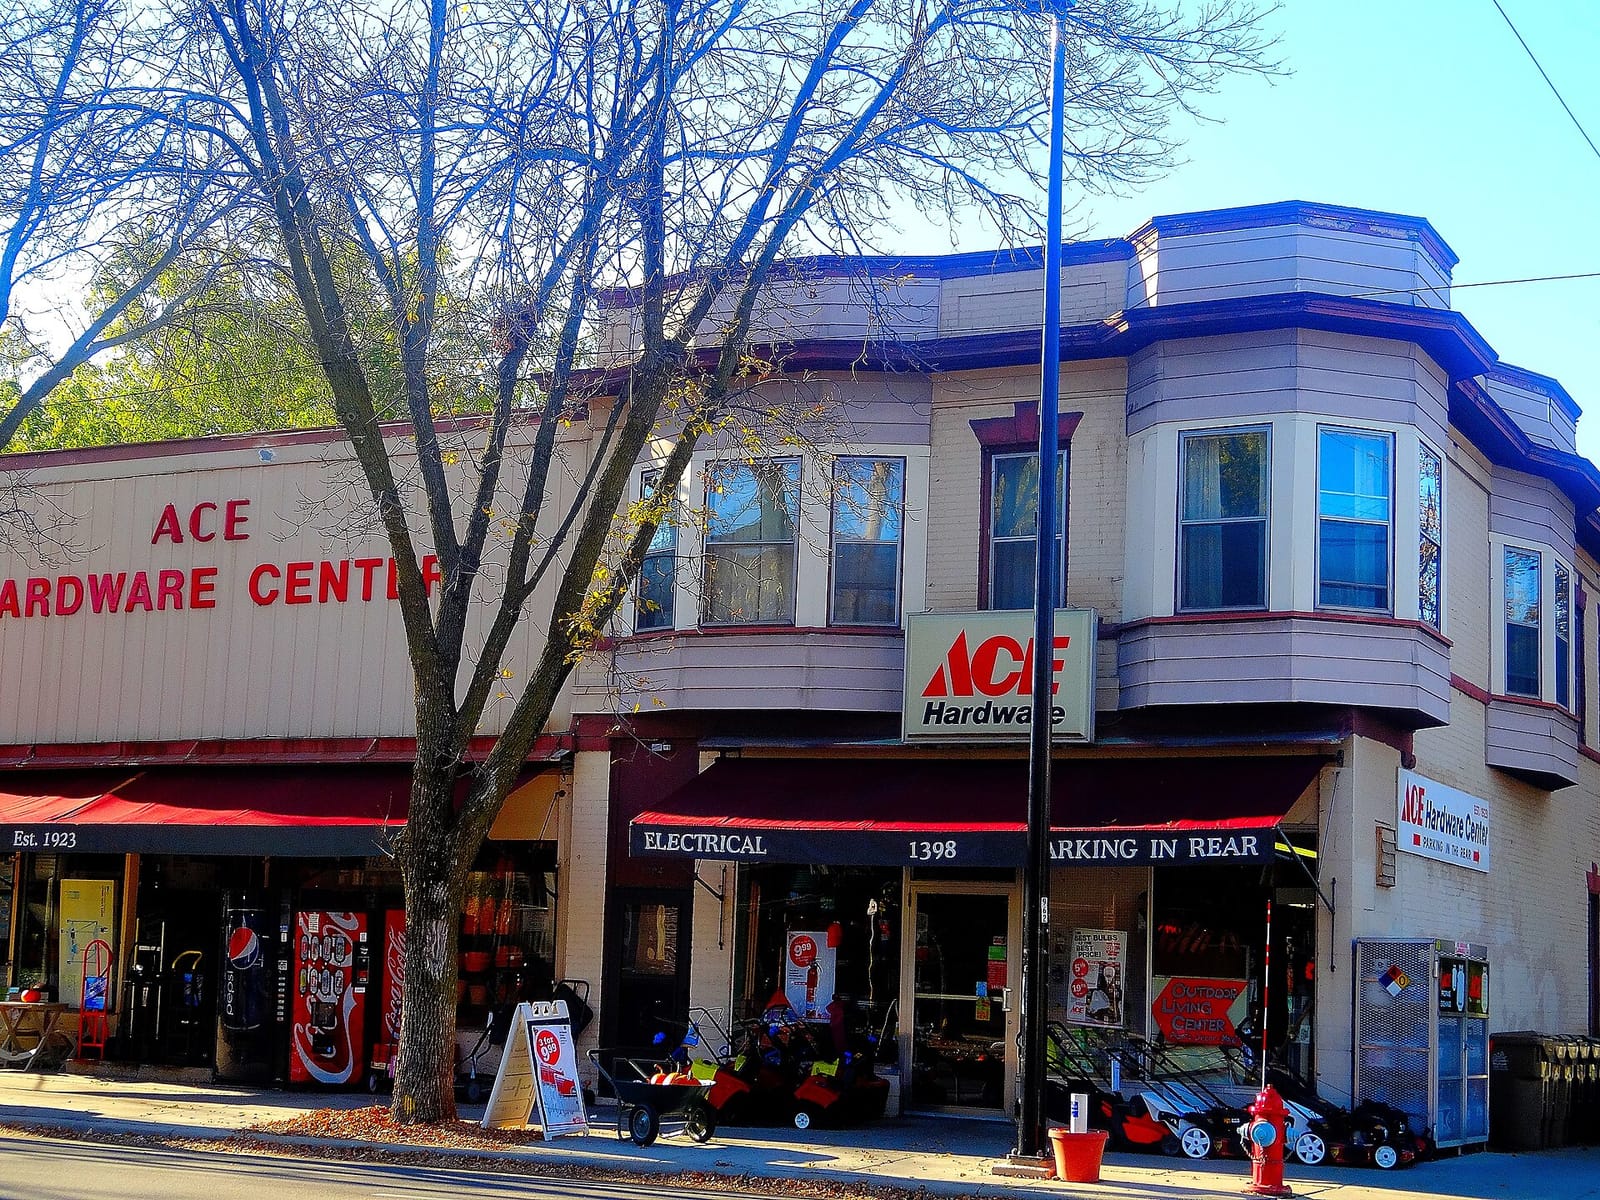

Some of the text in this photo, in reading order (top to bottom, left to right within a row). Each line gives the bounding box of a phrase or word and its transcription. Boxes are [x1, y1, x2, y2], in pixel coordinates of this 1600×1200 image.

[151, 498, 250, 545] ACE
[921, 628, 1071, 697] ACE
[922, 700, 1067, 726] Hardwae
[1401, 779, 1489, 846] ACE Hardware Center
[13, 830, 76, 848] Est. 1923
[644, 831, 767, 855] ELECTRICAL
[909, 841, 957, 860] 1398
[1050, 836, 1259, 859] ARKING IN REAR
[1423, 836, 1472, 860] PARKING IN THE REAR
[226, 970, 234, 1016] pepsi
[1171, 983, 1238, 999] OUTDOOR
[1161, 998, 1212, 1015] LIVING
[1171, 1015, 1225, 1032] CENTER
[538, 1038, 544, 1047] 3
[544, 1036, 554, 1045] for
